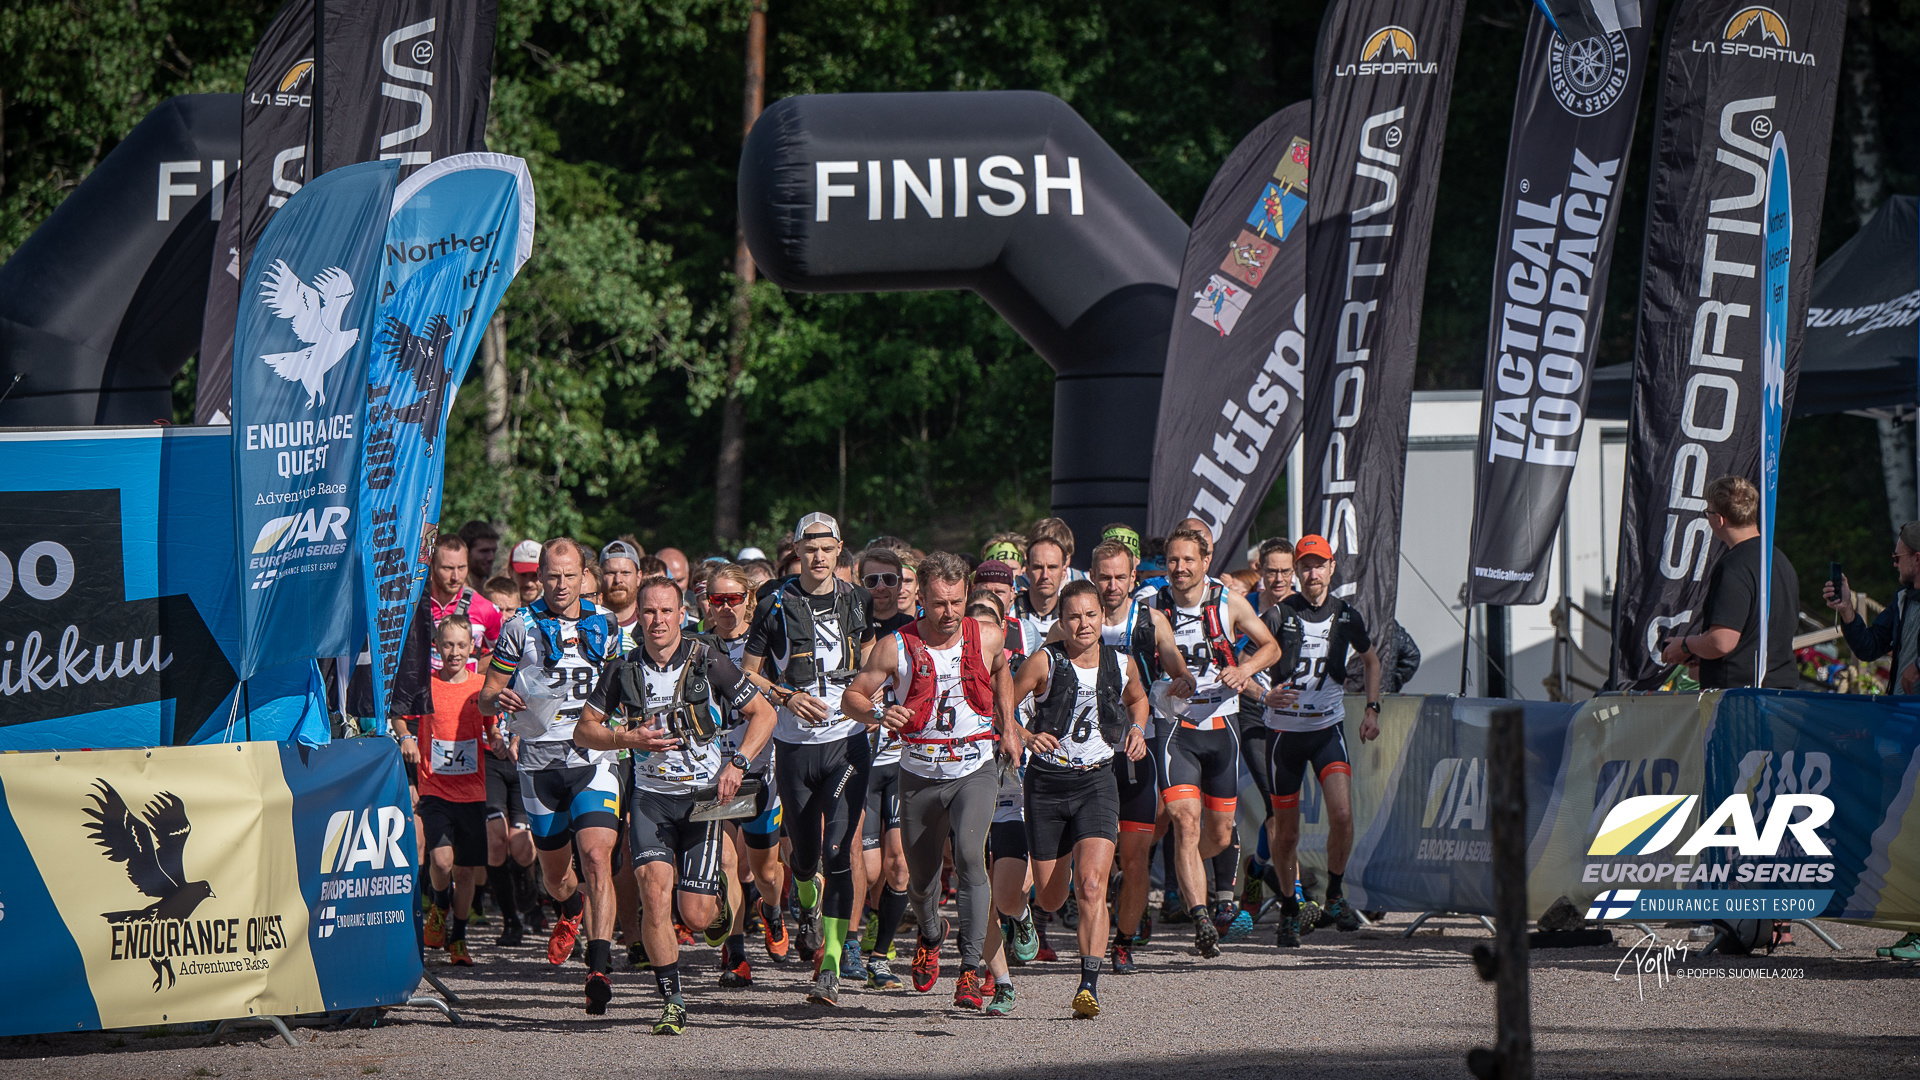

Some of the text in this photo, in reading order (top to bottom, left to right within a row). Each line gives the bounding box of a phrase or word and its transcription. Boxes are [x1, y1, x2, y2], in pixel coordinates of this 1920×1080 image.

[1336, 62, 1438, 77] LA SPORTIVA
[1692, 40, 1816, 66] LA SPORTIVA
[1552, 34, 1577, 108] DESIGNE
[251, 92, 312, 107] LA SPO
[1585, 67, 1626, 112] FORCES
[157, 160, 241, 221] FI
[816, 154, 1085, 222] FINISH
[1525, 148, 1621, 467] FOODPACK
[1187, 294, 1306, 546] ultisp
[277, 444, 330, 479] QUEST
[317, 482, 347, 496] Race
[292, 506, 351, 548] AR
[300, 563, 318, 573] QUEST
[319, 561, 338, 571] ESPOO
[305, 543, 347, 557] SERIES
[0, 625, 174, 696] ikkuu
[1291, 657, 1328, 691] 29
[541, 666, 594, 701] 28
[936, 689, 957, 732] 6
[1071, 706, 1093, 744] 6
[443, 750, 466, 767] 54
[833, 764, 854, 798] noname
[344, 805, 410, 872] AR
[1417, 838, 1468, 862] EUROPEAN
[321, 873, 412, 901] EUROPEAN SERIES
[681, 879, 711, 890] HALTI
[336, 909, 405, 928] ENDURANCE QUEST ESPOO
[110, 914, 287, 960] ENDURANCE QUEST
[179, 957, 270, 976] Adventure Race
